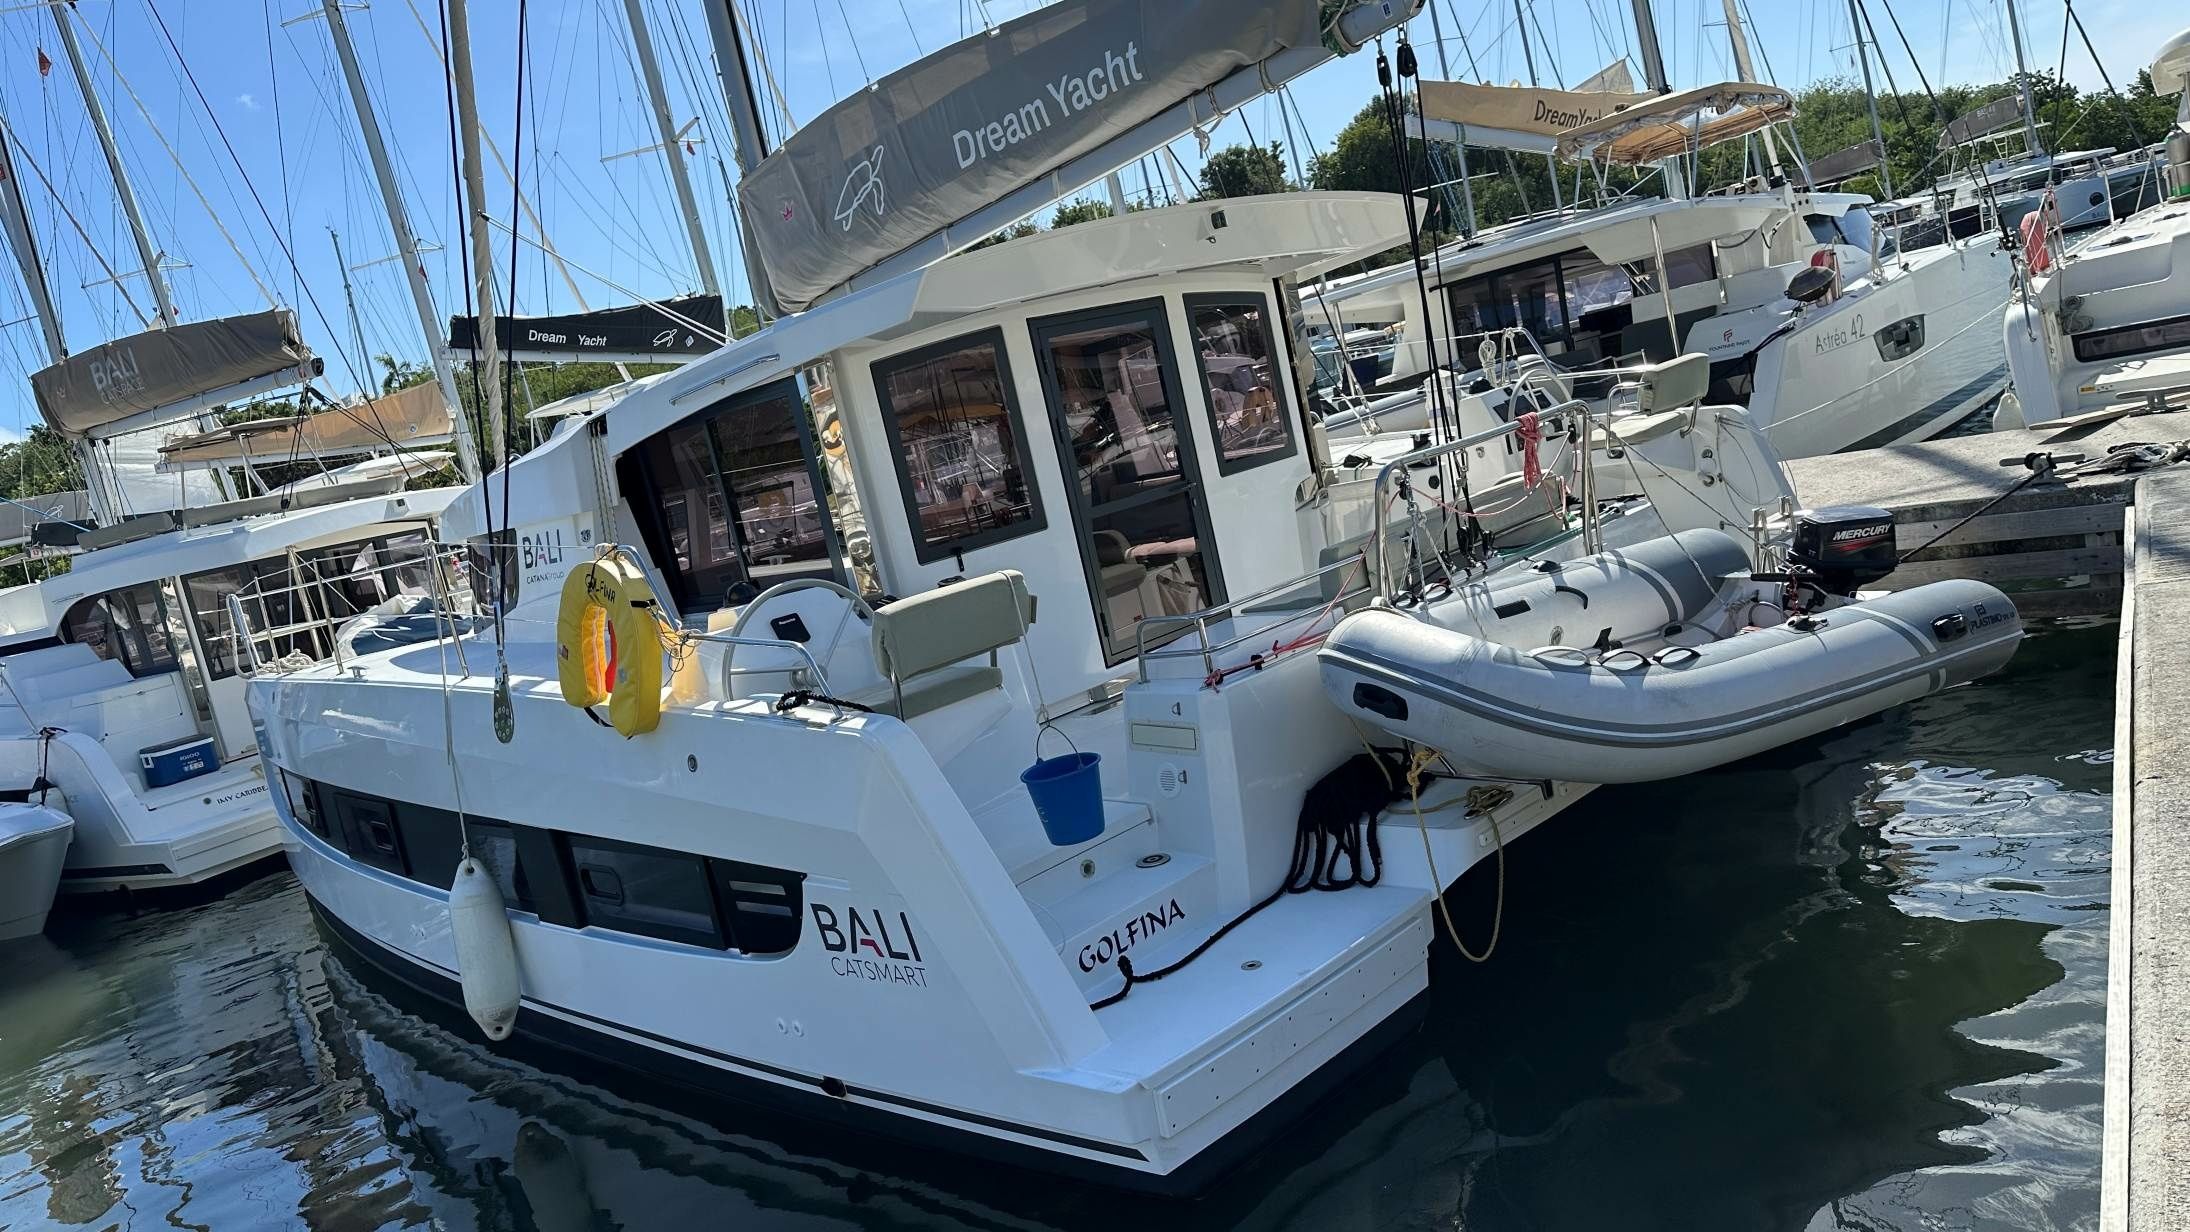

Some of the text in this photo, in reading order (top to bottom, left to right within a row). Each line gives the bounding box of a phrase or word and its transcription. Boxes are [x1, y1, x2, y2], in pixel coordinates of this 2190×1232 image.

[952, 41, 1144, 170] Dream Yacht
[528, 329, 607, 346] Dream Yacht
[1851, 313, 1866, 340] 42
[89, 346, 139, 391] BALI
[522, 529, 563, 569] BALI
[1832, 523, 1891, 541] MERCURY
[810, 902, 922, 962] BALI
[1078, 898, 1186, 973] GOLFINA
[831, 956, 927, 988] CATSMART
